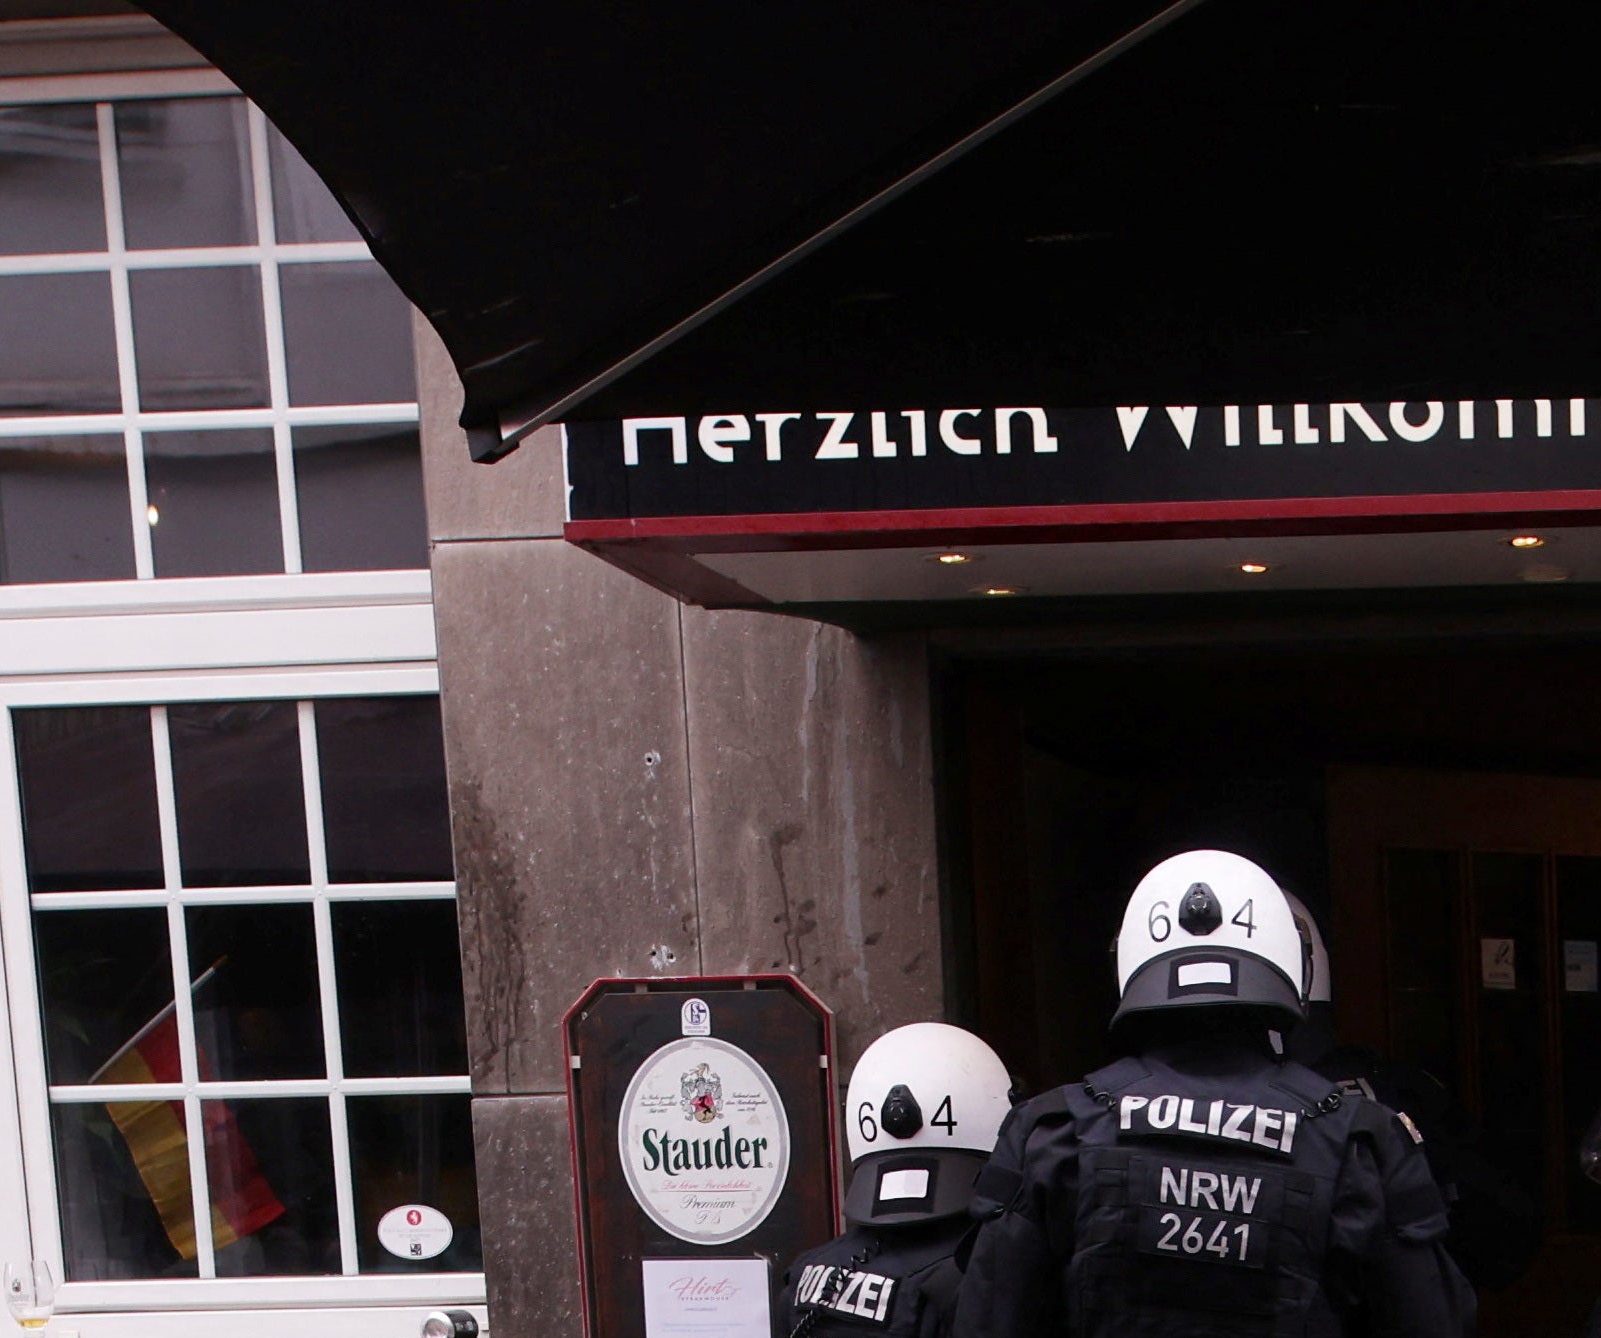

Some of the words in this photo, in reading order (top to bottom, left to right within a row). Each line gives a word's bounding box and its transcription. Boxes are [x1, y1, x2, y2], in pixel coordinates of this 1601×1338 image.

[1148, 901, 1171, 942] 6
[1231, 898, 1257, 939] 4
[858, 1101, 878, 1143] 6
[930, 1095, 958, 1136] 4
[1120, 1095, 1297, 1153] POLIZEI
[642, 1126, 768, 1176] Stauder
[680, 1194, 736, 1209] Premium
[1159, 1166, 1262, 1214] NRW
[695, 1209, 721, 1224] Pls
[1157, 1213, 1251, 1261] 2641
[794, 1265, 895, 1322] POLIZEI
